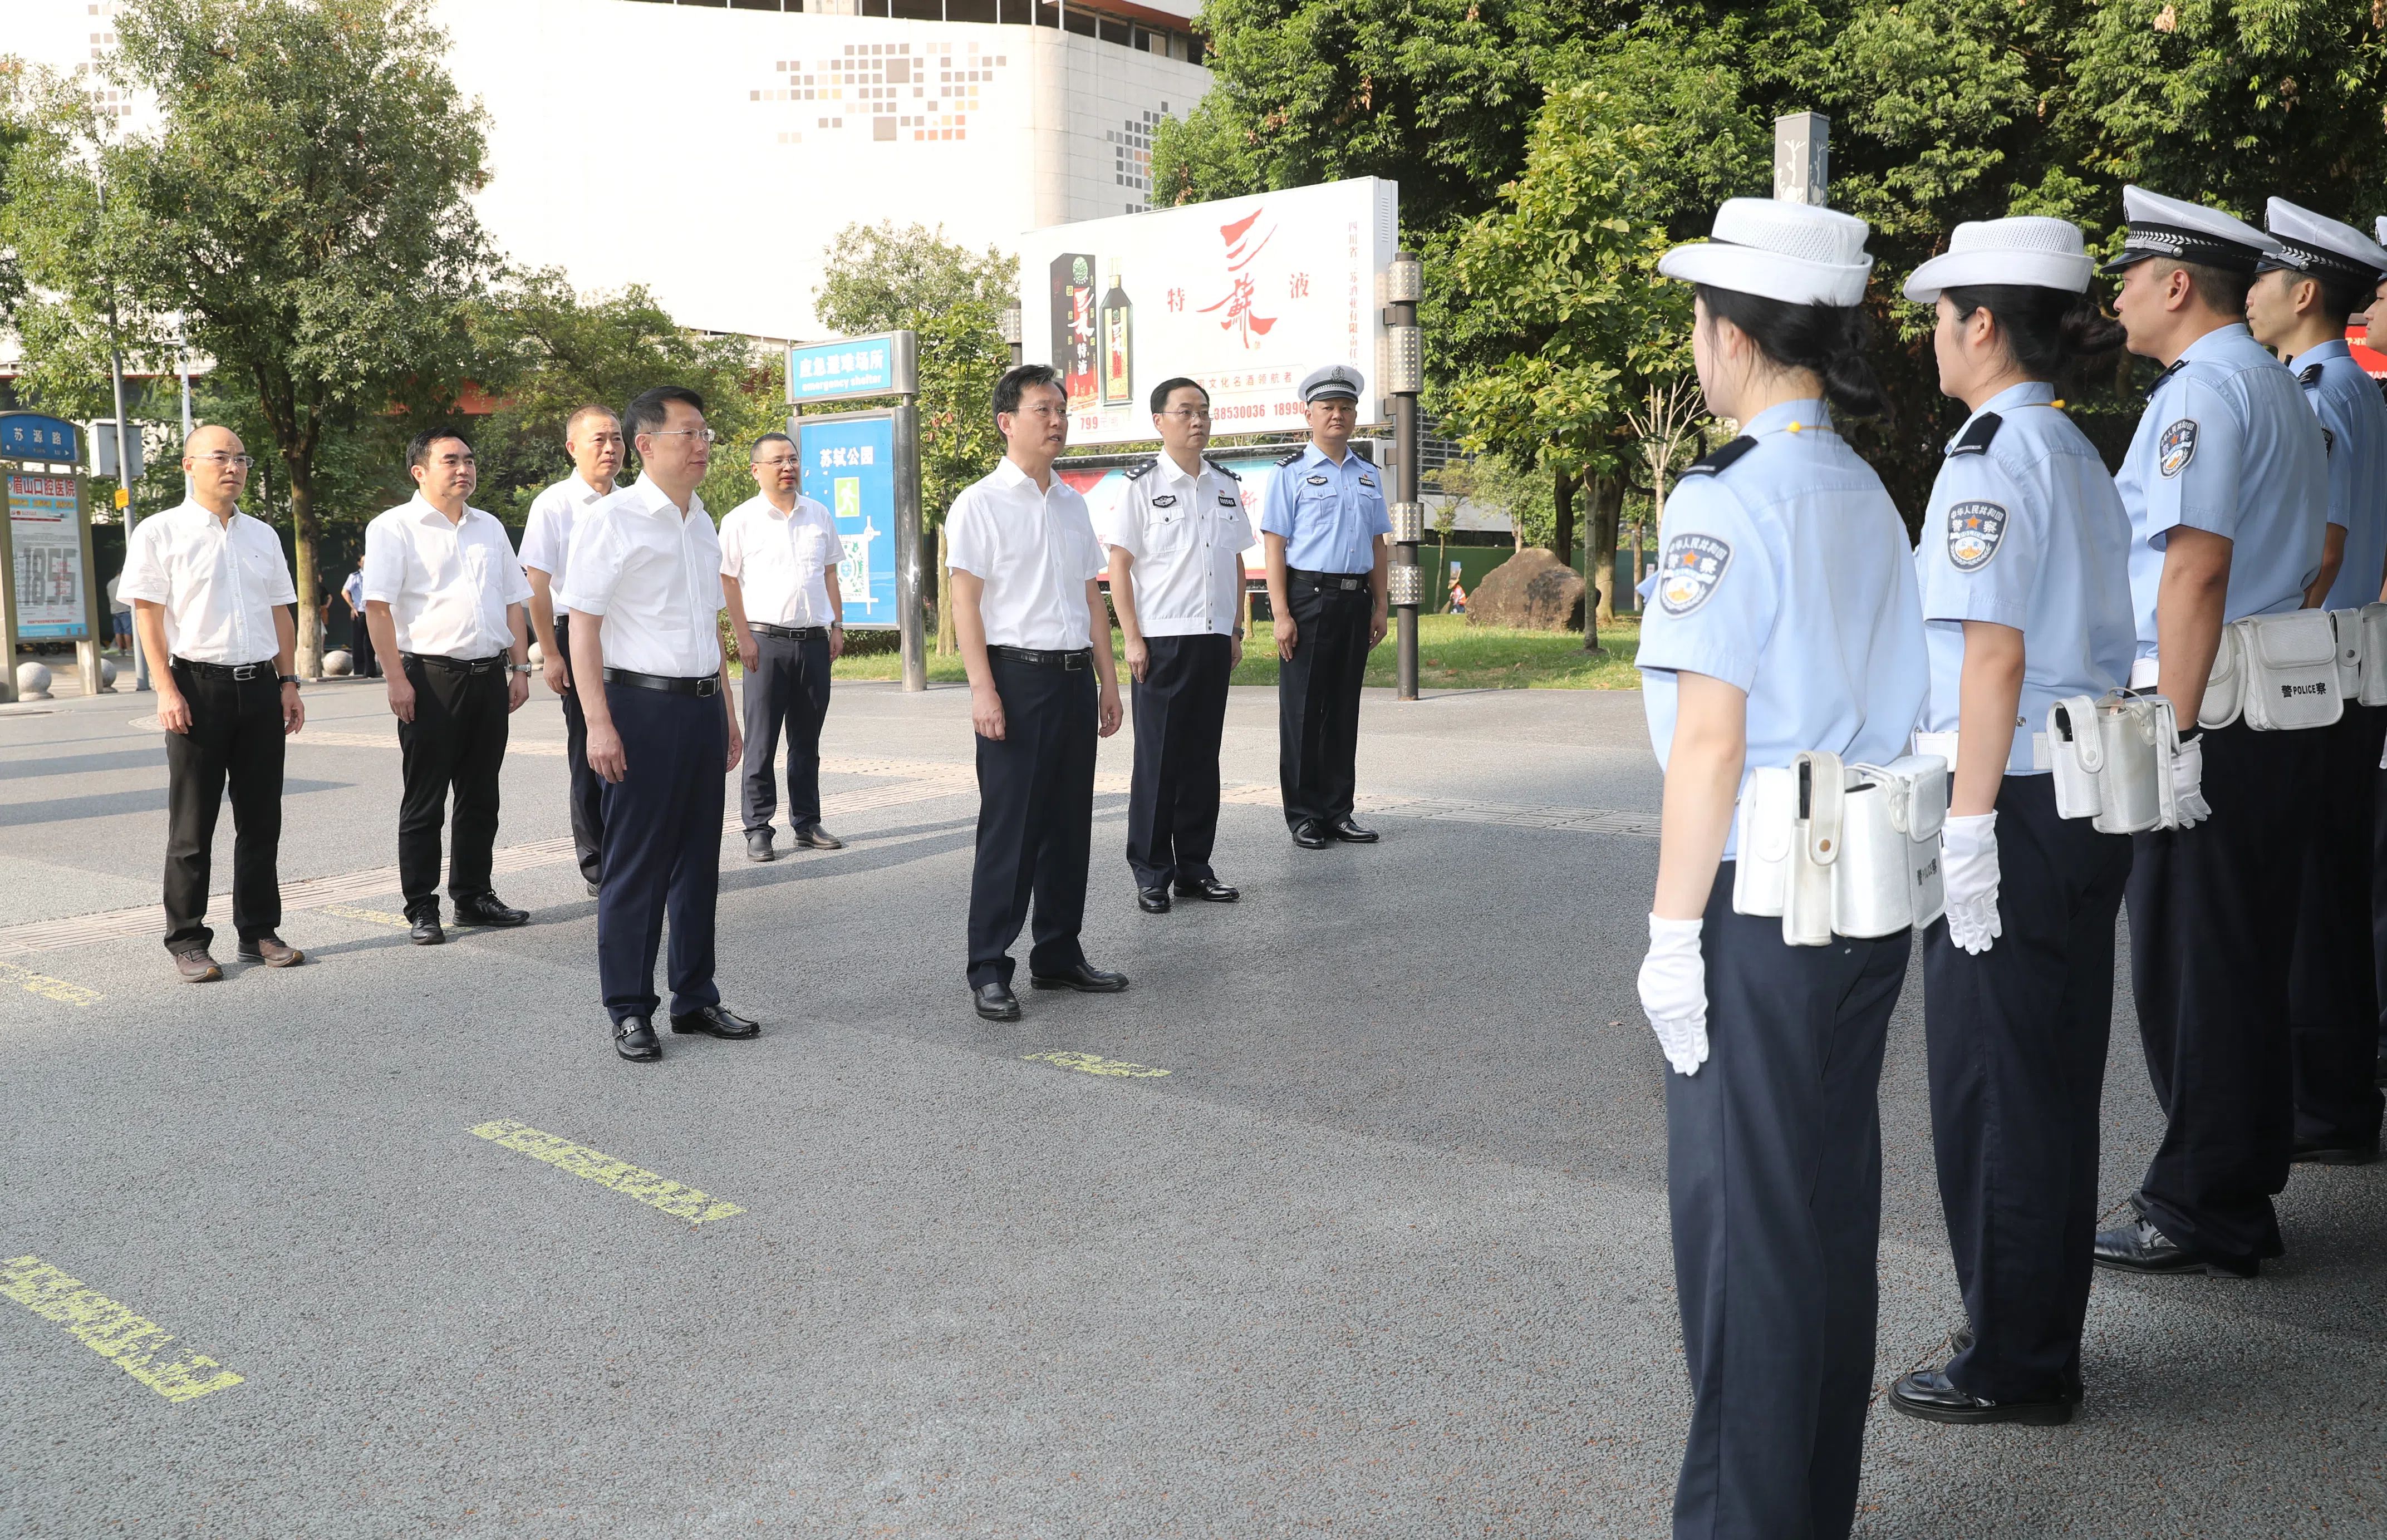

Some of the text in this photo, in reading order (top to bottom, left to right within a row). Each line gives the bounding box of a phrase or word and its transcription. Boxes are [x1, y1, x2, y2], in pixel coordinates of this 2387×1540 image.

[802, 373, 882, 392] emergency shelter
[13, 427, 62, 445] 苏源路
[819, 445, 873, 468] 苏轼公园
[13, 475, 76, 497] 眉山口腔医院
[1951, 504, 2004, 522] 中华人民共和国
[1951, 519, 1997, 534] 警 察
[1668, 537, 1728, 561] 中华人民共和国
